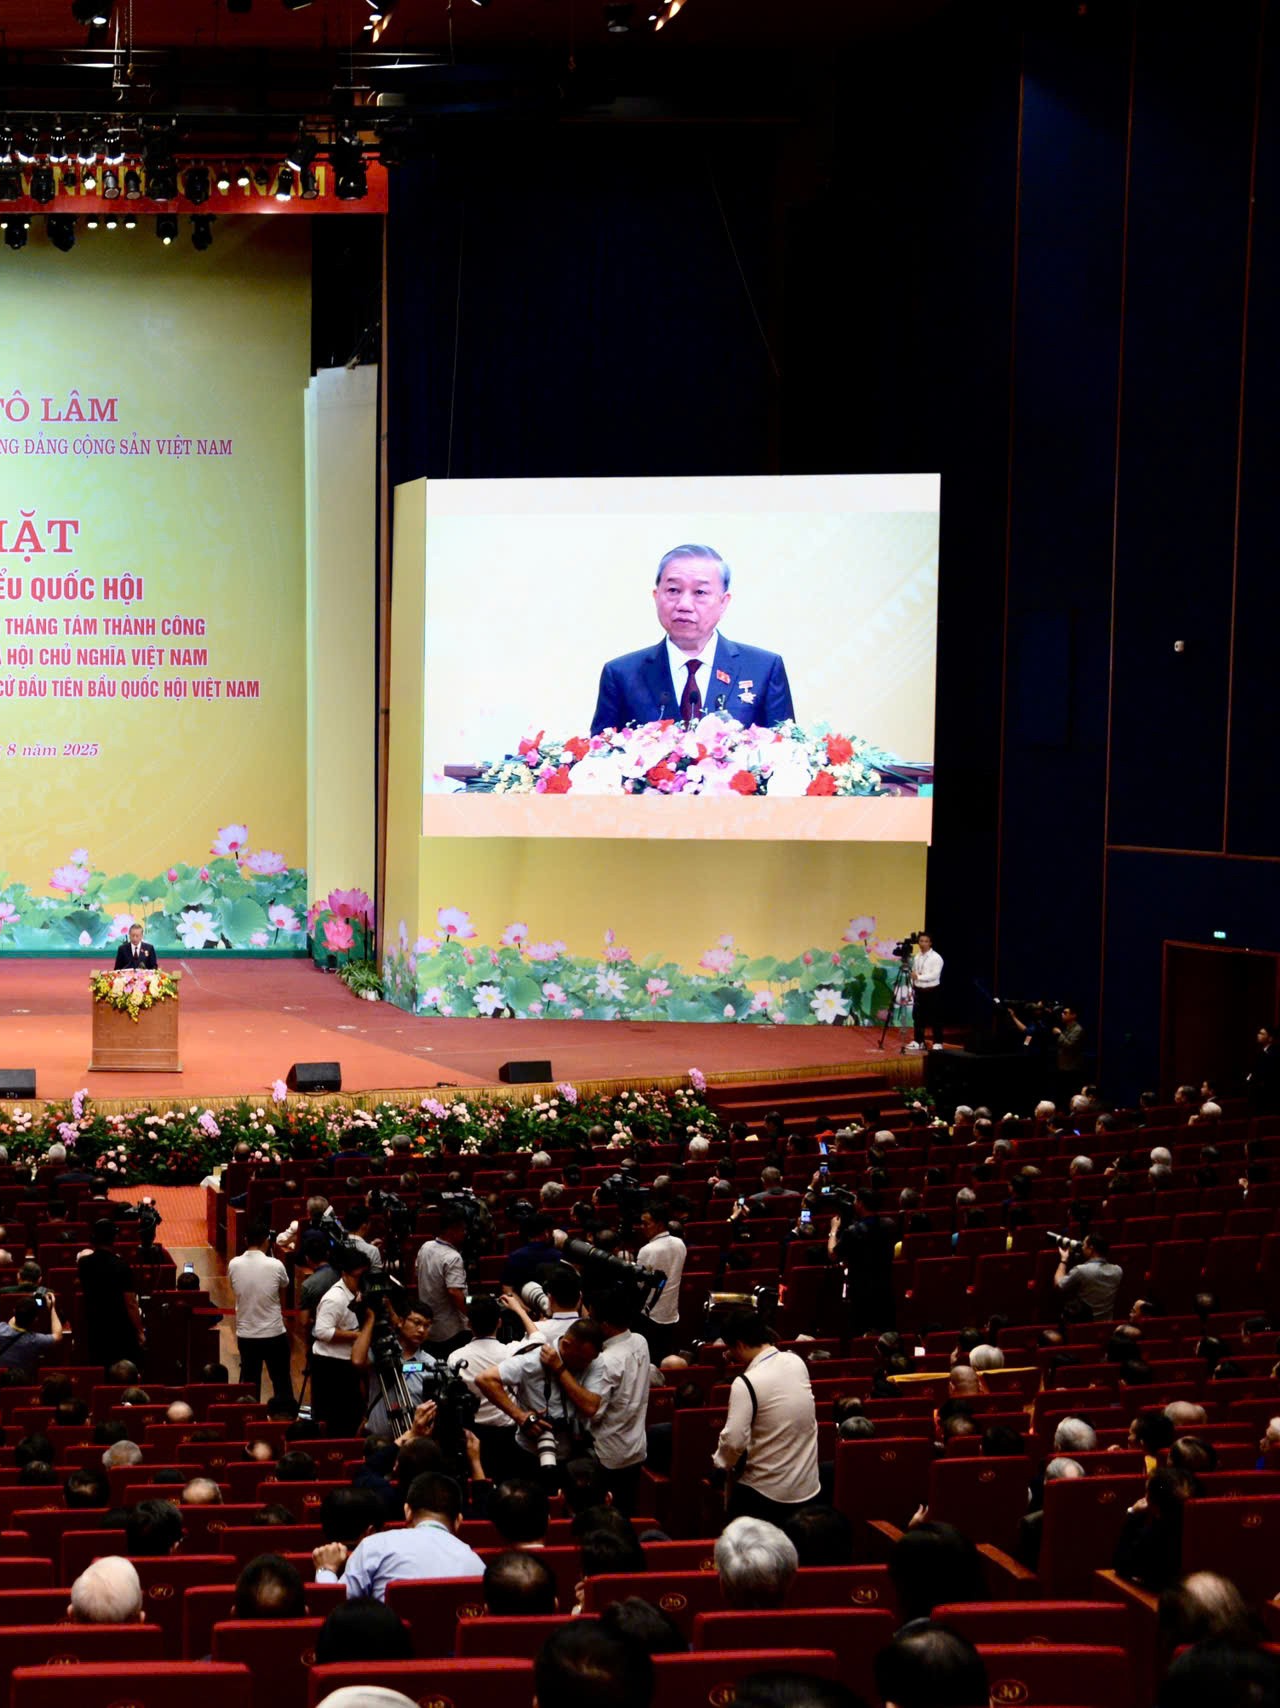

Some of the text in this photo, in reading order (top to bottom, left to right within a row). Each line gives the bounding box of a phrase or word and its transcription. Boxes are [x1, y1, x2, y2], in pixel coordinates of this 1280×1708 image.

[41, 390, 118, 422] LÂM
[24, 431, 68, 455] ĐẢNG
[72, 433, 116, 458] CỘNG
[120, 432, 151, 455] SẢN
[156, 434, 192, 459] VIỆT
[196, 439, 232, 455] NAM
[30, 569, 95, 600] QUỐC
[103, 572, 144, 606] HỘI
[5, 614, 59, 635] THÁNG
[63, 614, 98, 635] TÁM
[103, 614, 157, 635] THÀNH
[161, 614, 206, 635] CÔNG
[7, 644, 34, 669] HỘI
[39, 641, 72, 665] CHỦ
[76, 644, 127, 665] NGHĨA
[131, 644, 166, 669] VIỆT
[169, 647, 209, 665] NAM
[17, 673, 48, 697] ĐẦU
[51, 676, 84, 697] TIÊN
[87, 673, 117, 697] BẦU
[120, 673, 160, 697] QUỐC
[163, 676, 189, 701] HỘI
[191, 676, 222, 701] VIỆT
[225, 679, 261, 697] NAM
[6, 743, 17, 756] 8
[22, 744, 57, 756] năm
[63, 743, 99, 756] 2025
